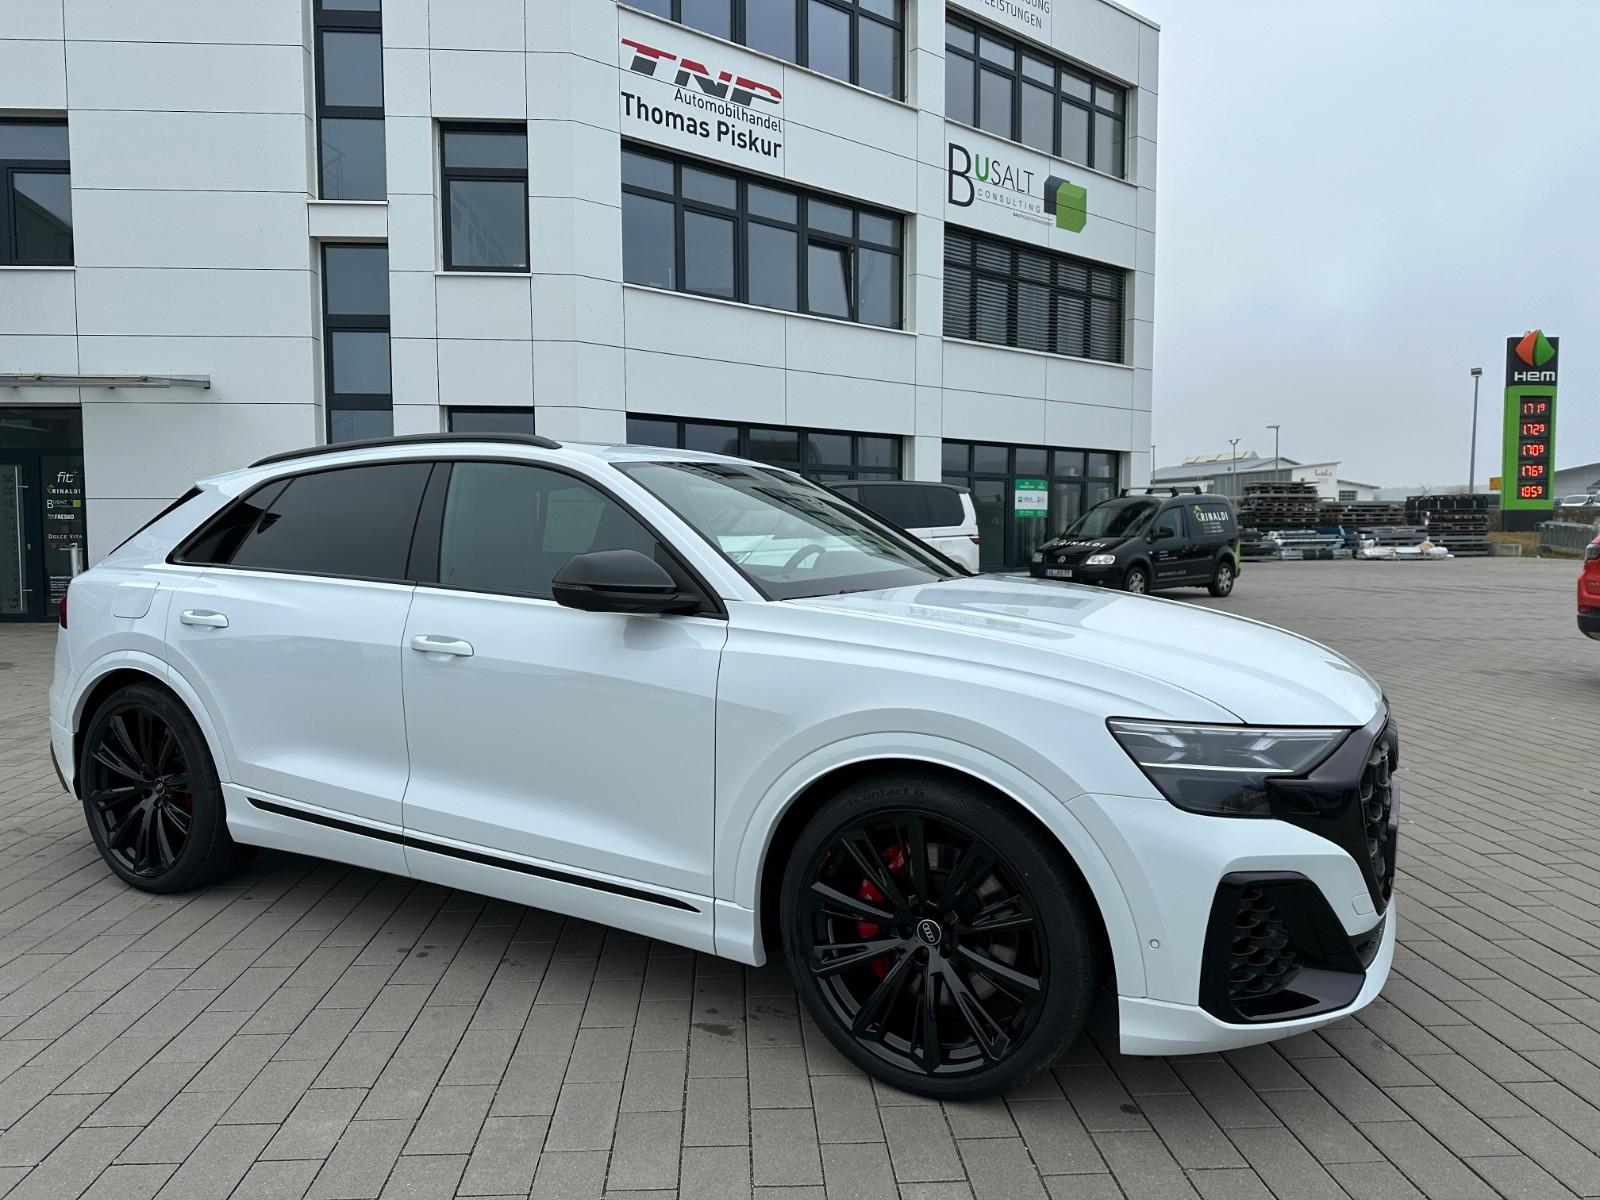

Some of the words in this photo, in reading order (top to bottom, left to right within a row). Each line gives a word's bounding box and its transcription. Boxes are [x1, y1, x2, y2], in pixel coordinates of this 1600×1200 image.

[621, 38, 782, 106] TNP
[621, 91, 710, 138] Thomas
[717, 120, 782, 158] Piskur
[674, 87, 782, 133] Automobilhandel
[977, 188, 1042, 214] CONSULTING
